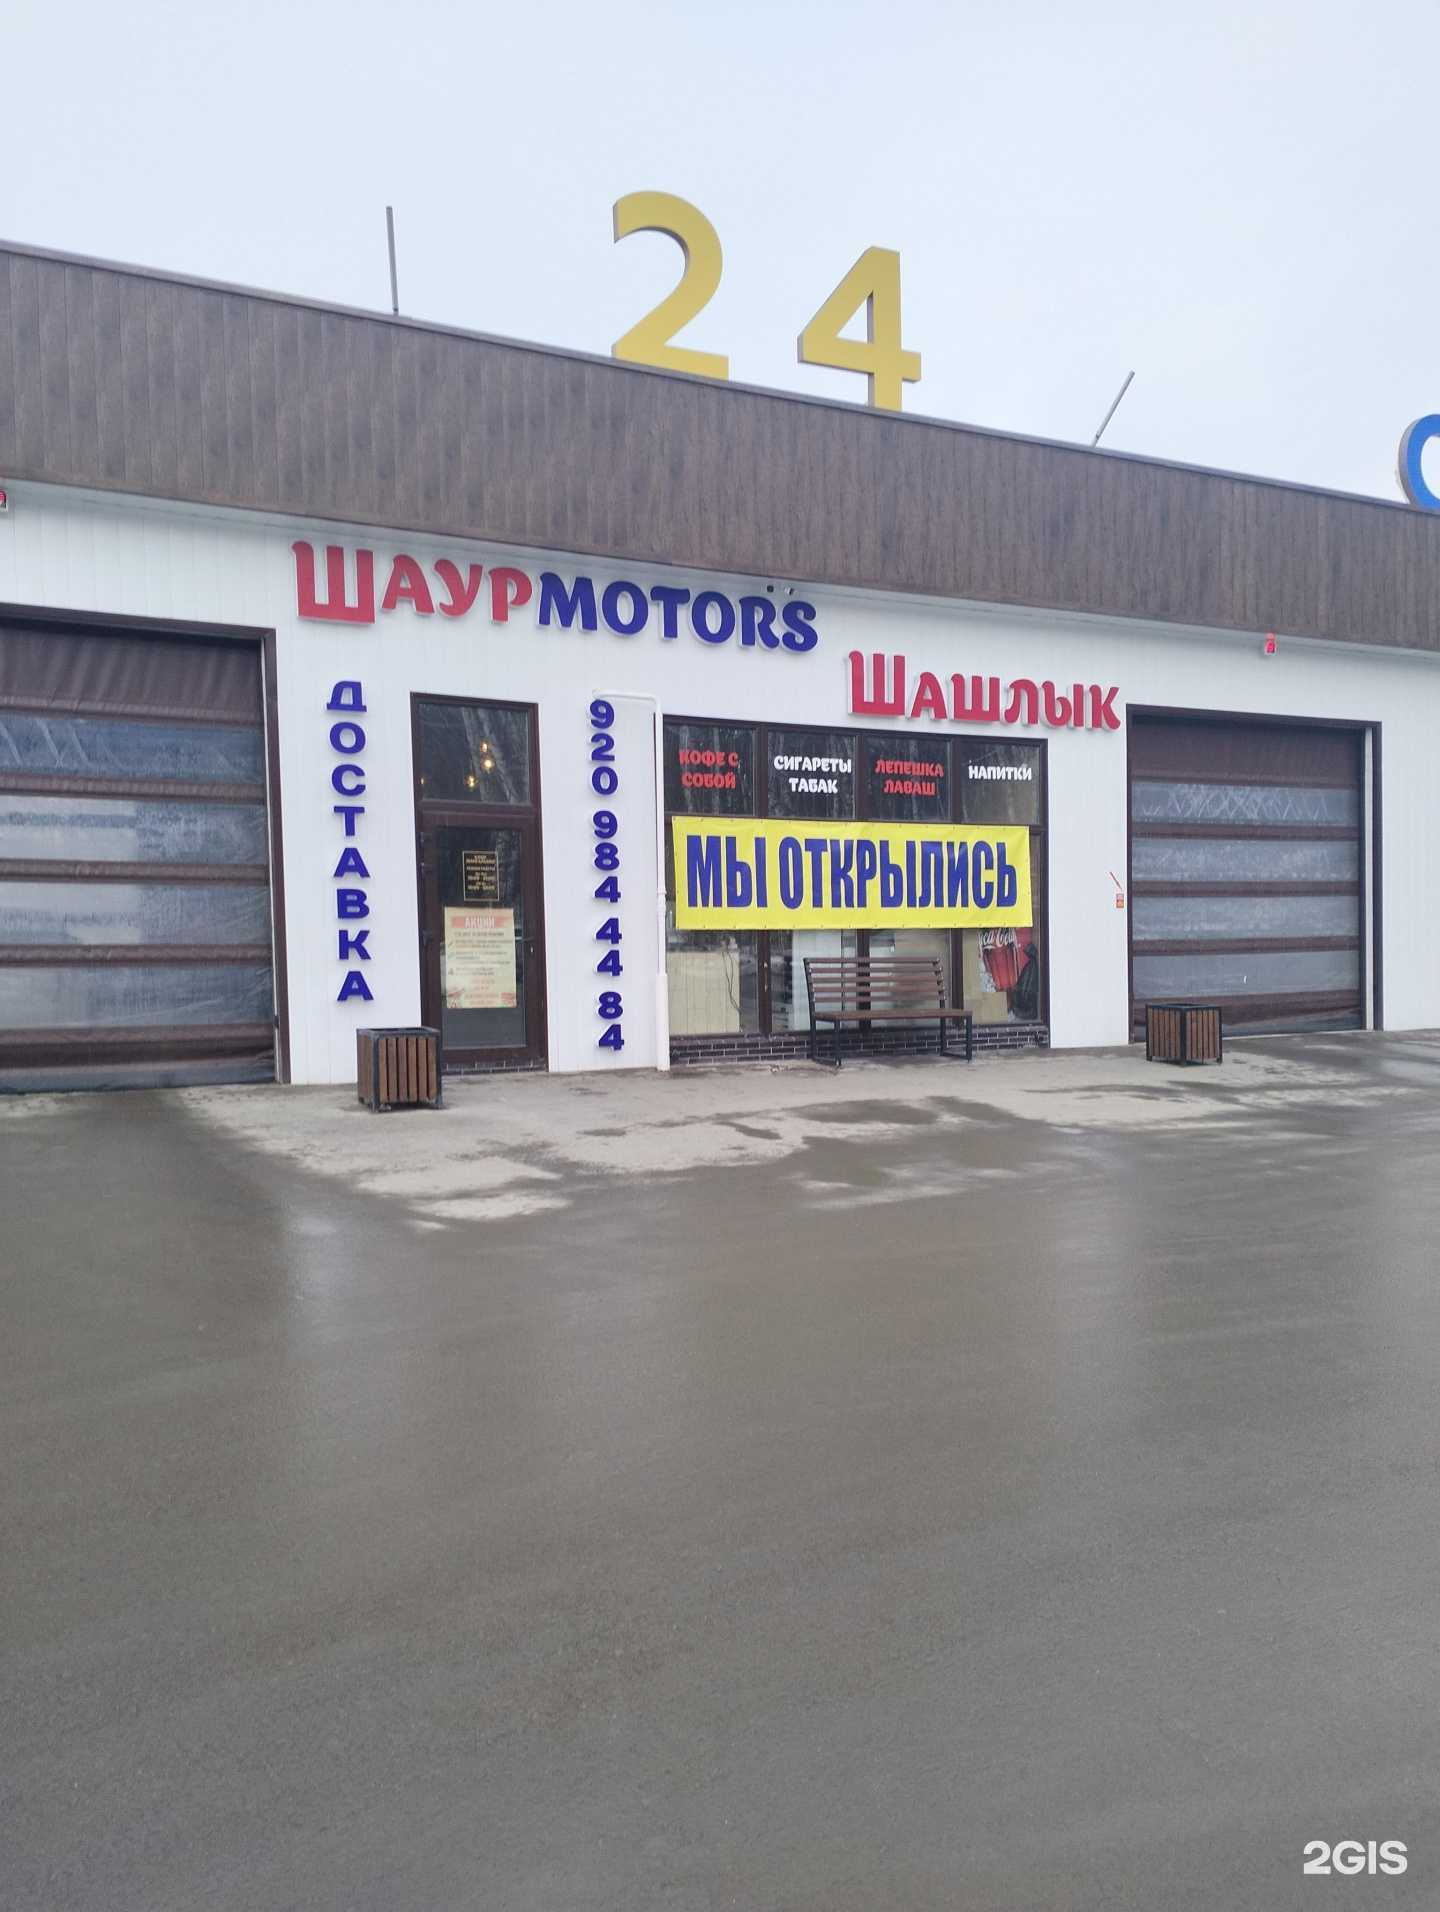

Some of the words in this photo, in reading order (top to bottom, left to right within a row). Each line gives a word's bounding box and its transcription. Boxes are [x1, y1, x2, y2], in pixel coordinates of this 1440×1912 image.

[848, 649, 1121, 730] ШАШЛЫК
[590, 699, 619, 796] 920
[678, 749, 726, 767] КОФЕ
[727, 752, 739, 767] С
[773, 755, 852, 773] СИГАРЕТЫ
[681, 771, 737, 789] СОБОЙ
[788, 777, 839, 794] ТАБАК
[875, 759, 945, 778] ЛЕПЕШКА
[883, 779, 936, 796] ЛАВАШ
[968, 764, 1033, 781] НАПИТКИ
[326, 680, 373, 1002] ДОСТАВКА
[592, 809, 620, 902] 984
[686, 834, 768, 908] МЫ
[778, 836, 1018, 909] ОТКРЫЛИСЬ
[595, 917, 622, 977] 44
[598, 991, 624, 1050] 84
